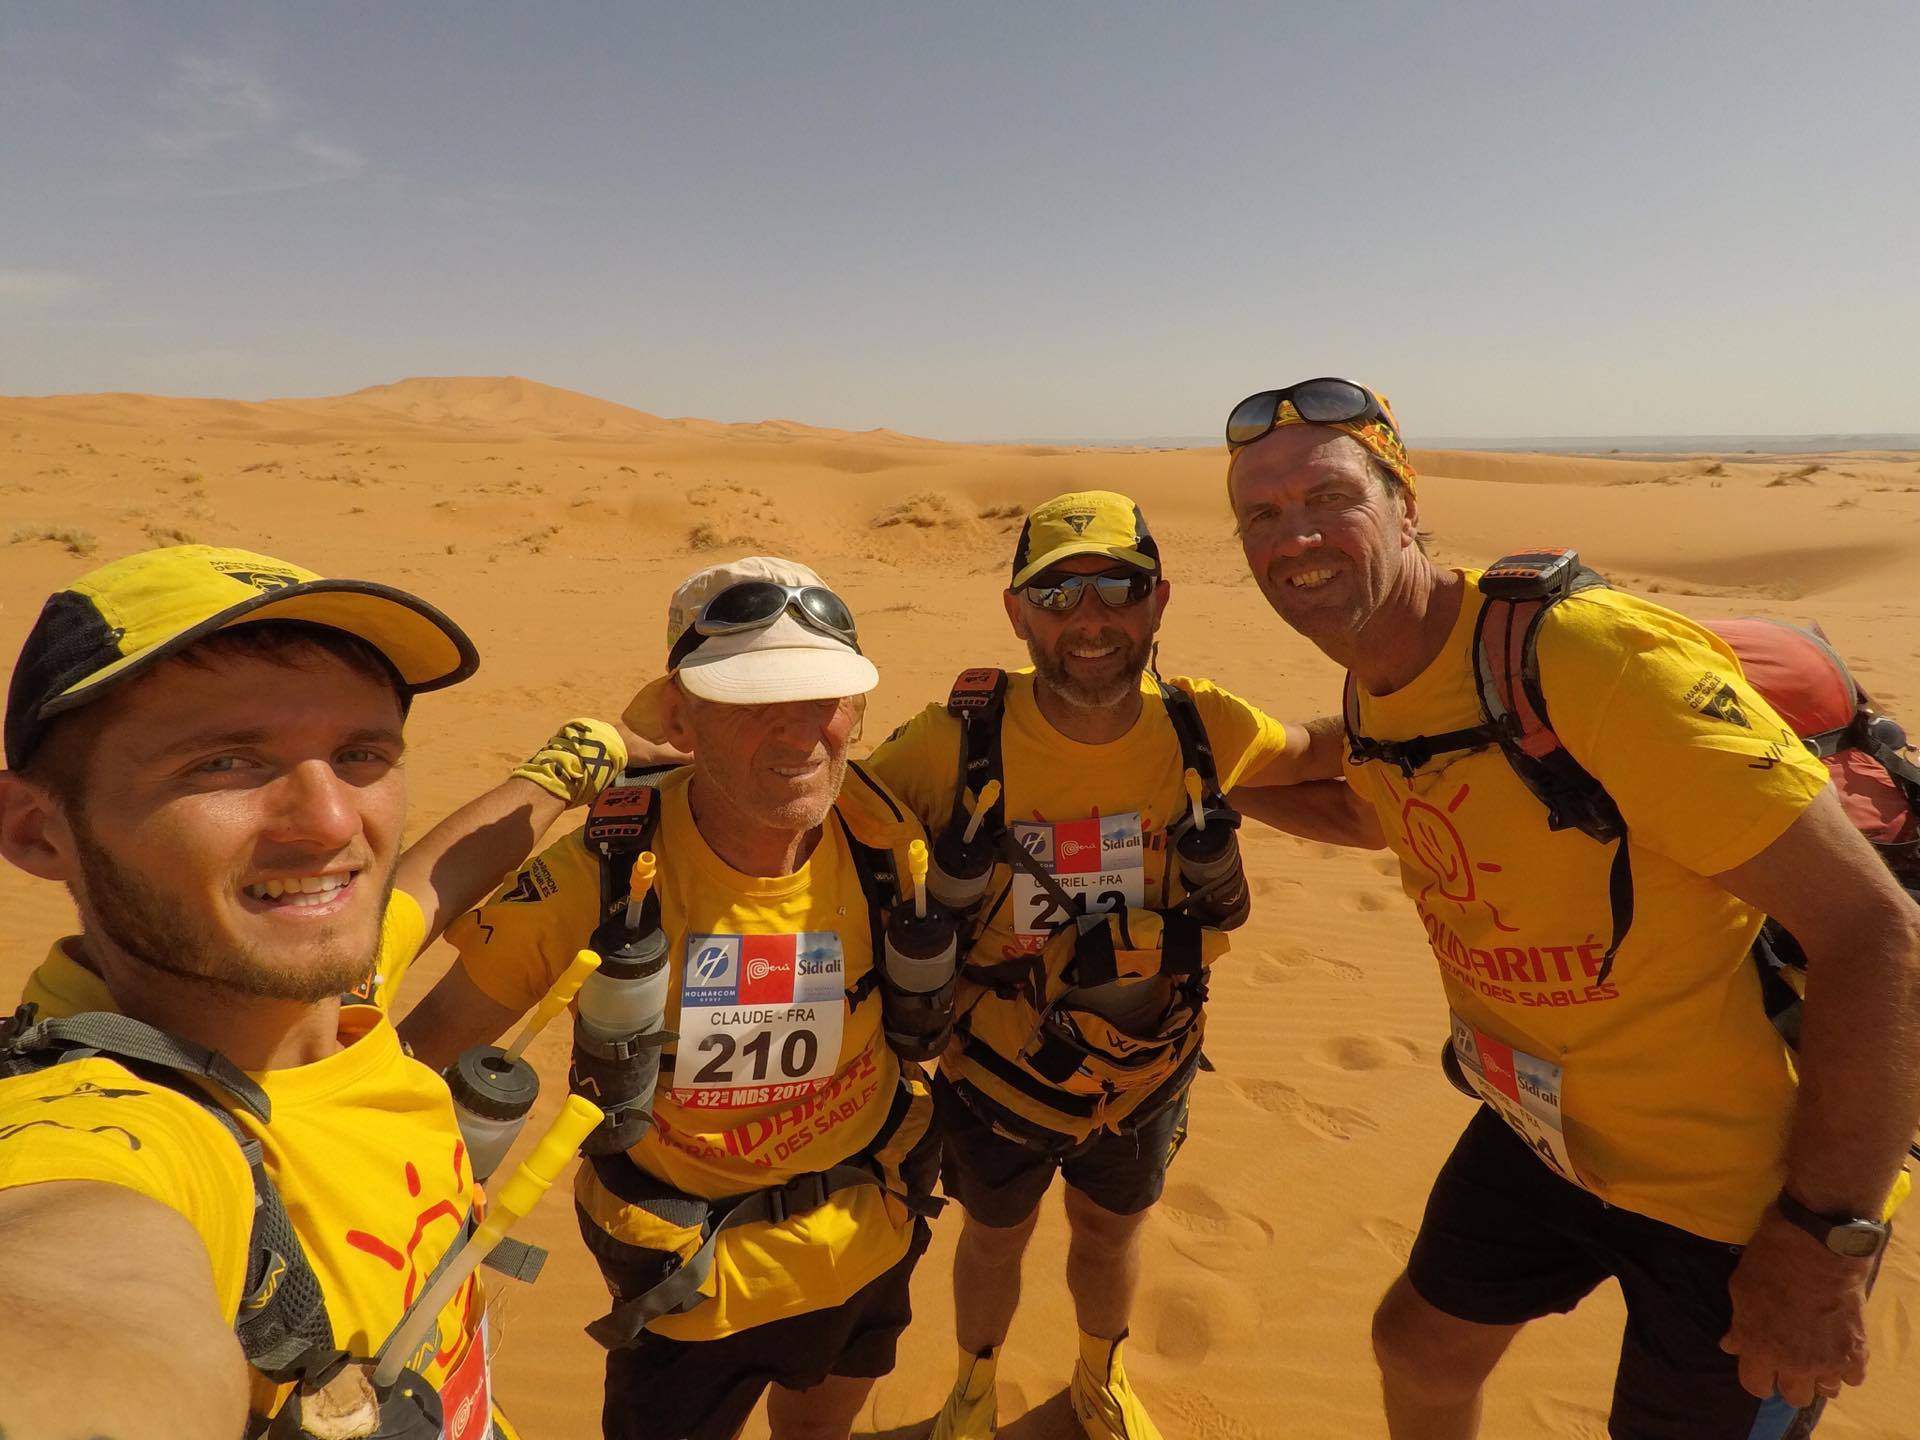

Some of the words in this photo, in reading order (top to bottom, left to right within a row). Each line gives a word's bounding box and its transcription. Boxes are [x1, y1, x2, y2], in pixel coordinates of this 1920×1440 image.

[1102, 837, 1124, 852] Sidi
[1126, 836, 1141, 849] ali
[1100, 874, 1123, 885] FRA
[1418, 905, 1611, 984] OLIDARITÉ
[797, 959, 824, 976] Sidi
[826, 959, 842, 973] ali
[685, 989, 736, 998] HOLMARCOM
[1480, 982, 1516, 1004] DES
[1518, 983, 1620, 1008] SABLES
[710, 1010, 773, 1026] CLAUDE
[786, 1008, 815, 1023] FRA
[693, 1028, 818, 1084] 210
[731, 1088, 769, 1106] MDS
[772, 1082, 810, 1101] 2017
[774, 1125, 813, 1162] DES
